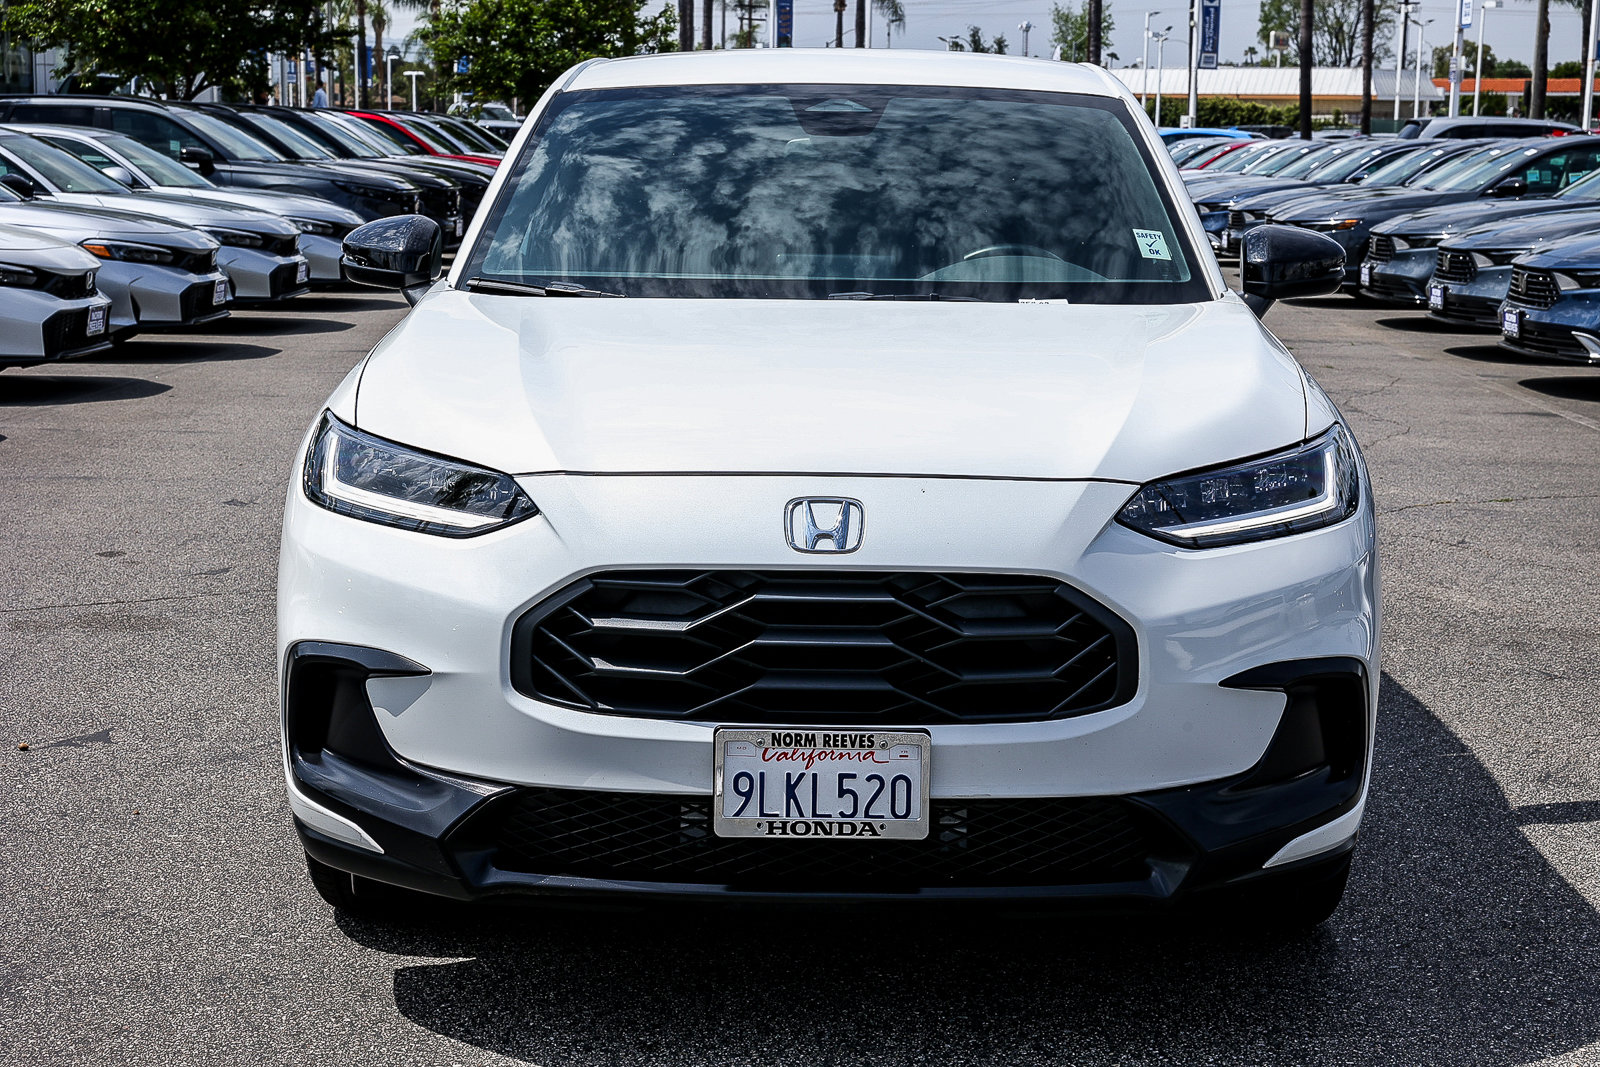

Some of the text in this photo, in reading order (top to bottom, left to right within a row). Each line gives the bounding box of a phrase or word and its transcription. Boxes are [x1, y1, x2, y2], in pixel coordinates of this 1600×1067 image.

[1136, 232, 1162, 240] SAFETY
[770, 733, 876, 748] NORM REEVES
[761, 747, 890, 770] California
[731, 771, 912, 819] 9LKL520
[764, 820, 882, 837] HONDA
